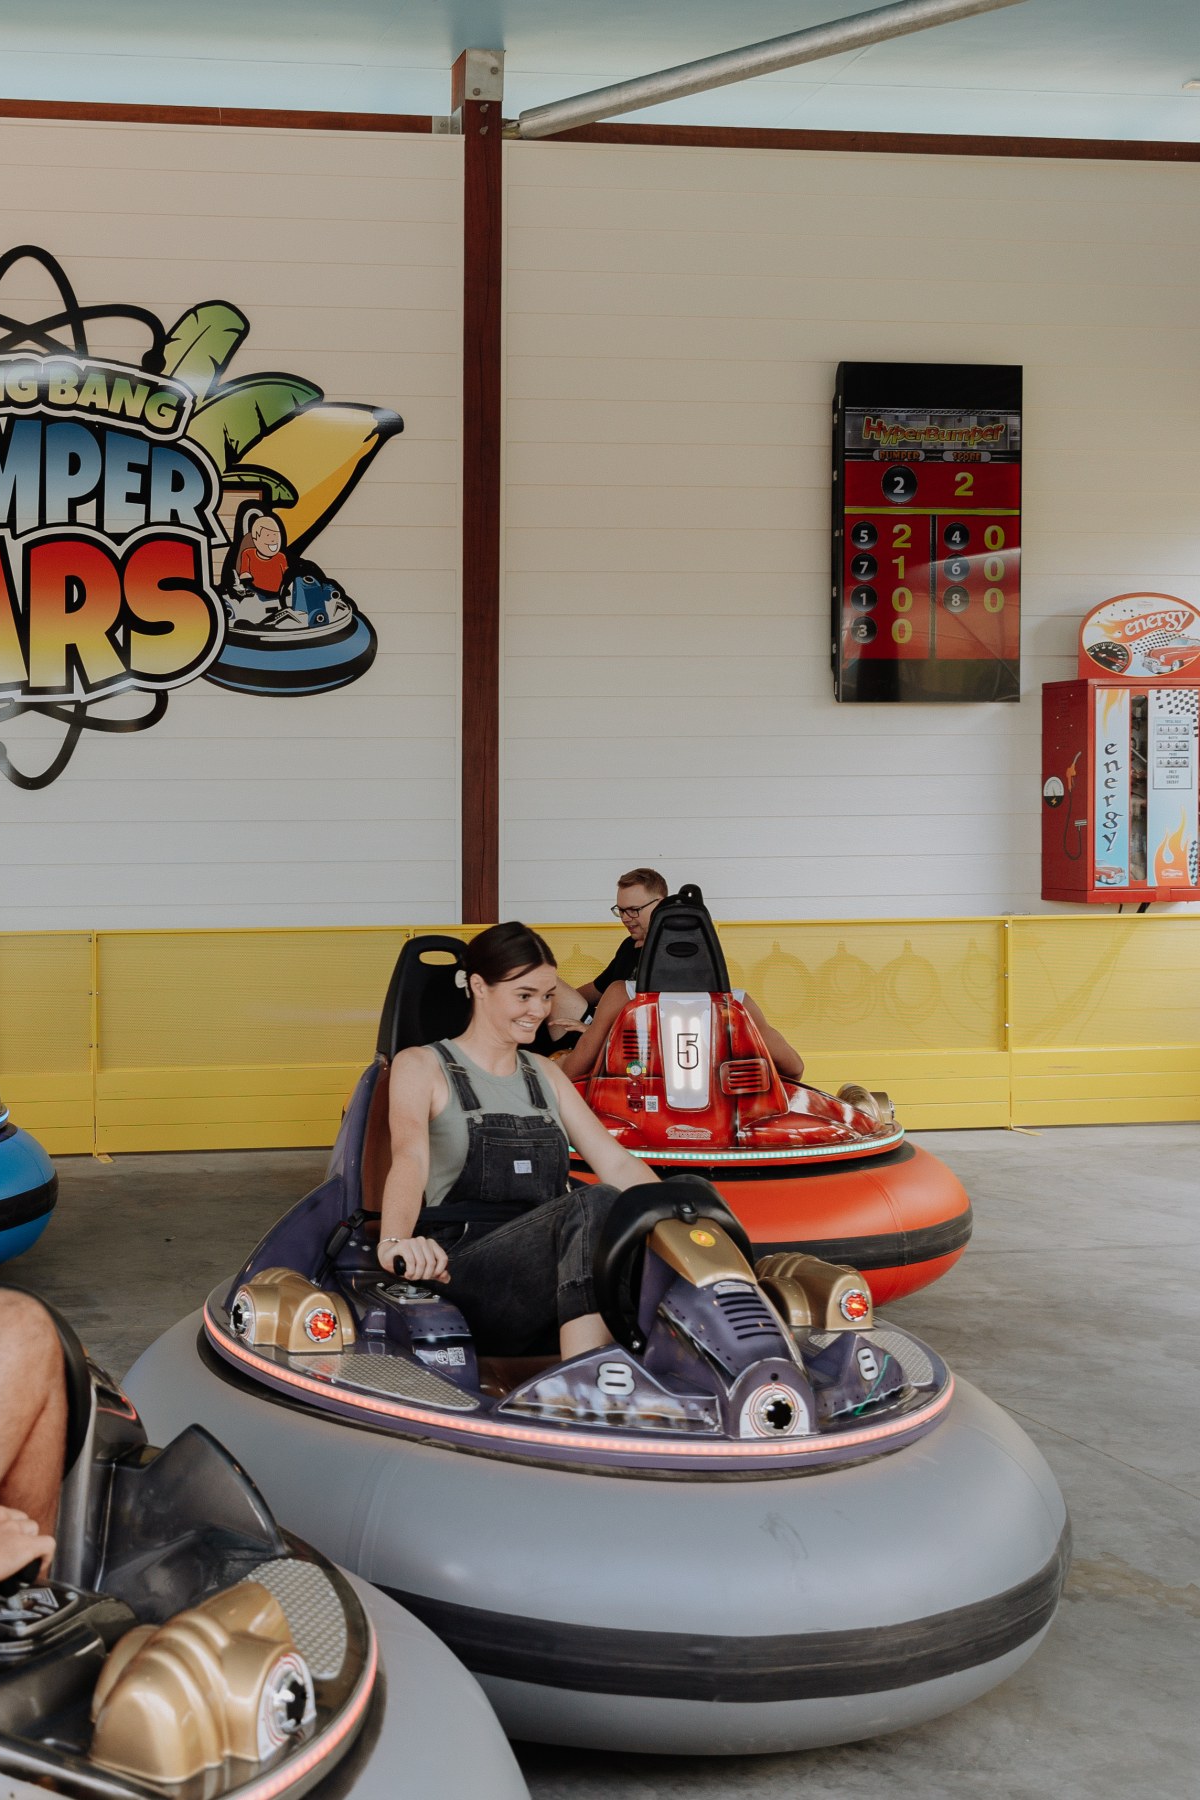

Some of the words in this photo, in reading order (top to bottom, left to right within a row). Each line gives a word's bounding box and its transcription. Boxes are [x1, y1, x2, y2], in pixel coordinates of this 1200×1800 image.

[48, 364, 178, 429] BANG
[862, 416, 1005, 447] HyperBumper
[878, 451, 921, 460] BUMPER
[952, 452, 982, 462] SCORE
[892, 476, 905, 494] 2
[954, 471, 974, 496] 2
[859, 530, 869, 543] 5
[892, 524, 912, 548] 2
[951, 531, 961, 544] 4
[984, 525, 1005, 550] 0
[859, 562, 869, 575] 7
[892, 556, 906, 579] 1
[951, 562, 961, 575] 6
[984, 556, 1005, 581] 0
[860, 593, 867, 605] 1
[891, 587, 913, 613] 0
[951, 594, 961, 607] 8
[984, 587, 1005, 613] 0
[858, 624, 868, 637] 3
[891, 618, 913, 644] 0
[1124, 611, 1190, 632] energy
[1102, 742, 1124, 852] energy
[677, 1033, 699, 1070] 5
[857, 1348, 879, 1381] 8
[596, 1361, 636, 1395] 8
